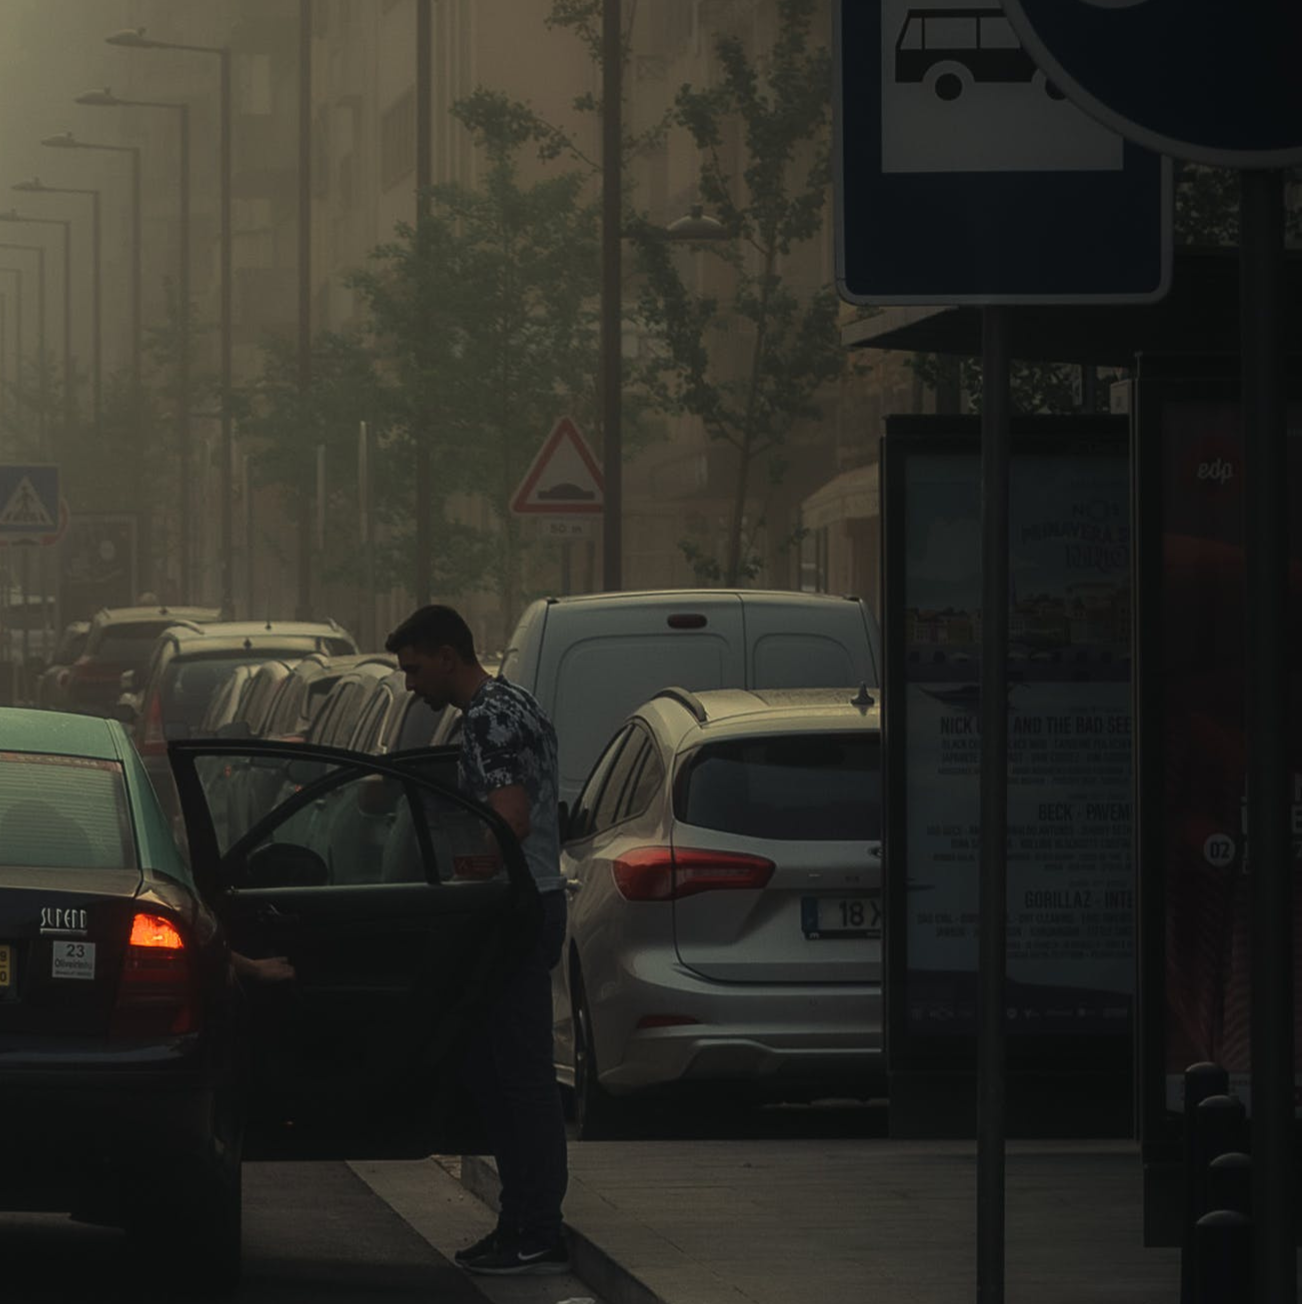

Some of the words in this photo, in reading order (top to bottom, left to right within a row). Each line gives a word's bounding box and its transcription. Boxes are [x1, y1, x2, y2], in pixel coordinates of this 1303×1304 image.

[1197, 457, 1234, 485] edp
[940, 715, 973, 734] NICK
[1013, 715, 1042, 734] AND
[1046, 715, 1072, 734] THE
[1076, 715, 1103, 734] BAD
[1038, 803, 1073, 821] BECK
[1209, 840, 1230, 860] 02
[1024, 889, 1092, 909] GORILLAZ
[66, 943, 85, 959] 23
